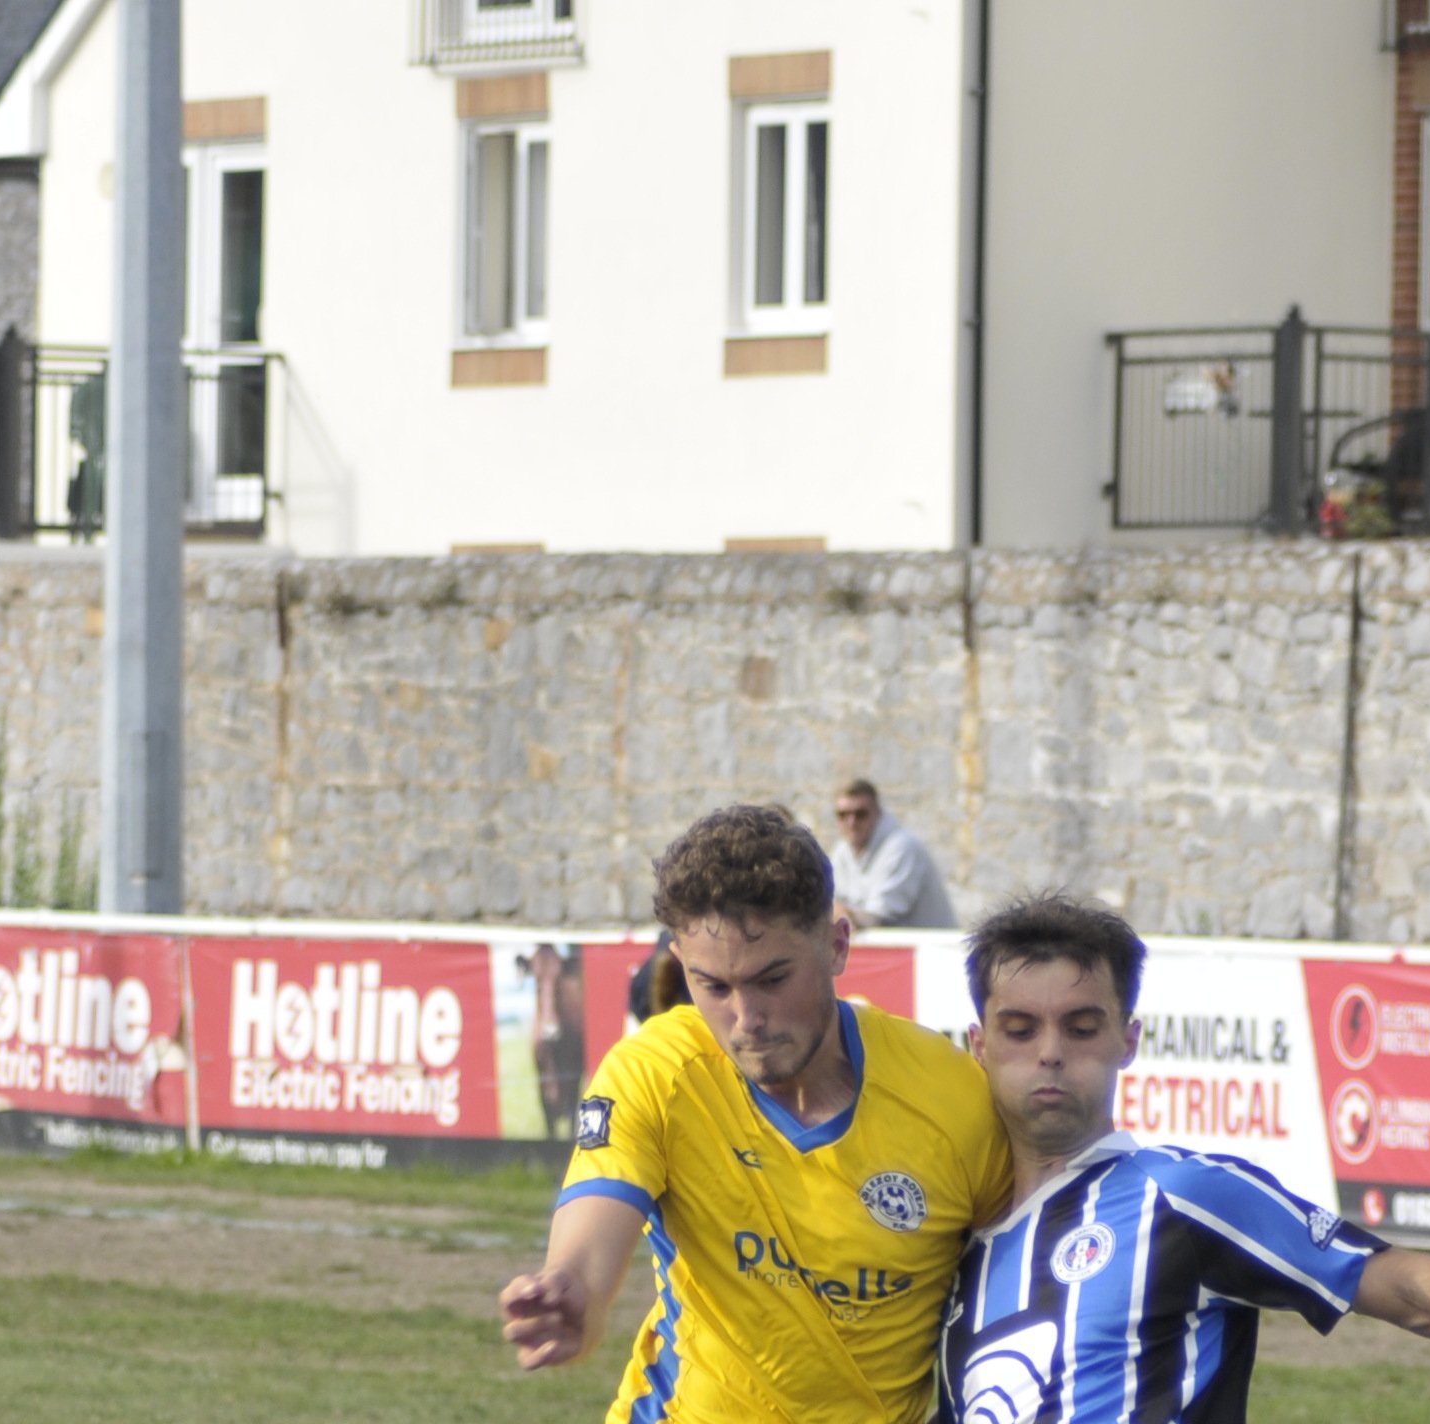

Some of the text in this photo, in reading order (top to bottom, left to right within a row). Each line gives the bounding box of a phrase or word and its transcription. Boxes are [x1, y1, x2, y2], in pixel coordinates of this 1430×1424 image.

[230, 959, 462, 1067] Hotline
[1141, 1014, 1289, 1065] HANICAL &
[45, 1046, 151, 1111] Fencing
[232, 1059, 460, 1126] Electric Fencing
[1116, 1075, 1288, 1141] ECTRICAL
[1381, 1125, 1430, 1150] HEATING
